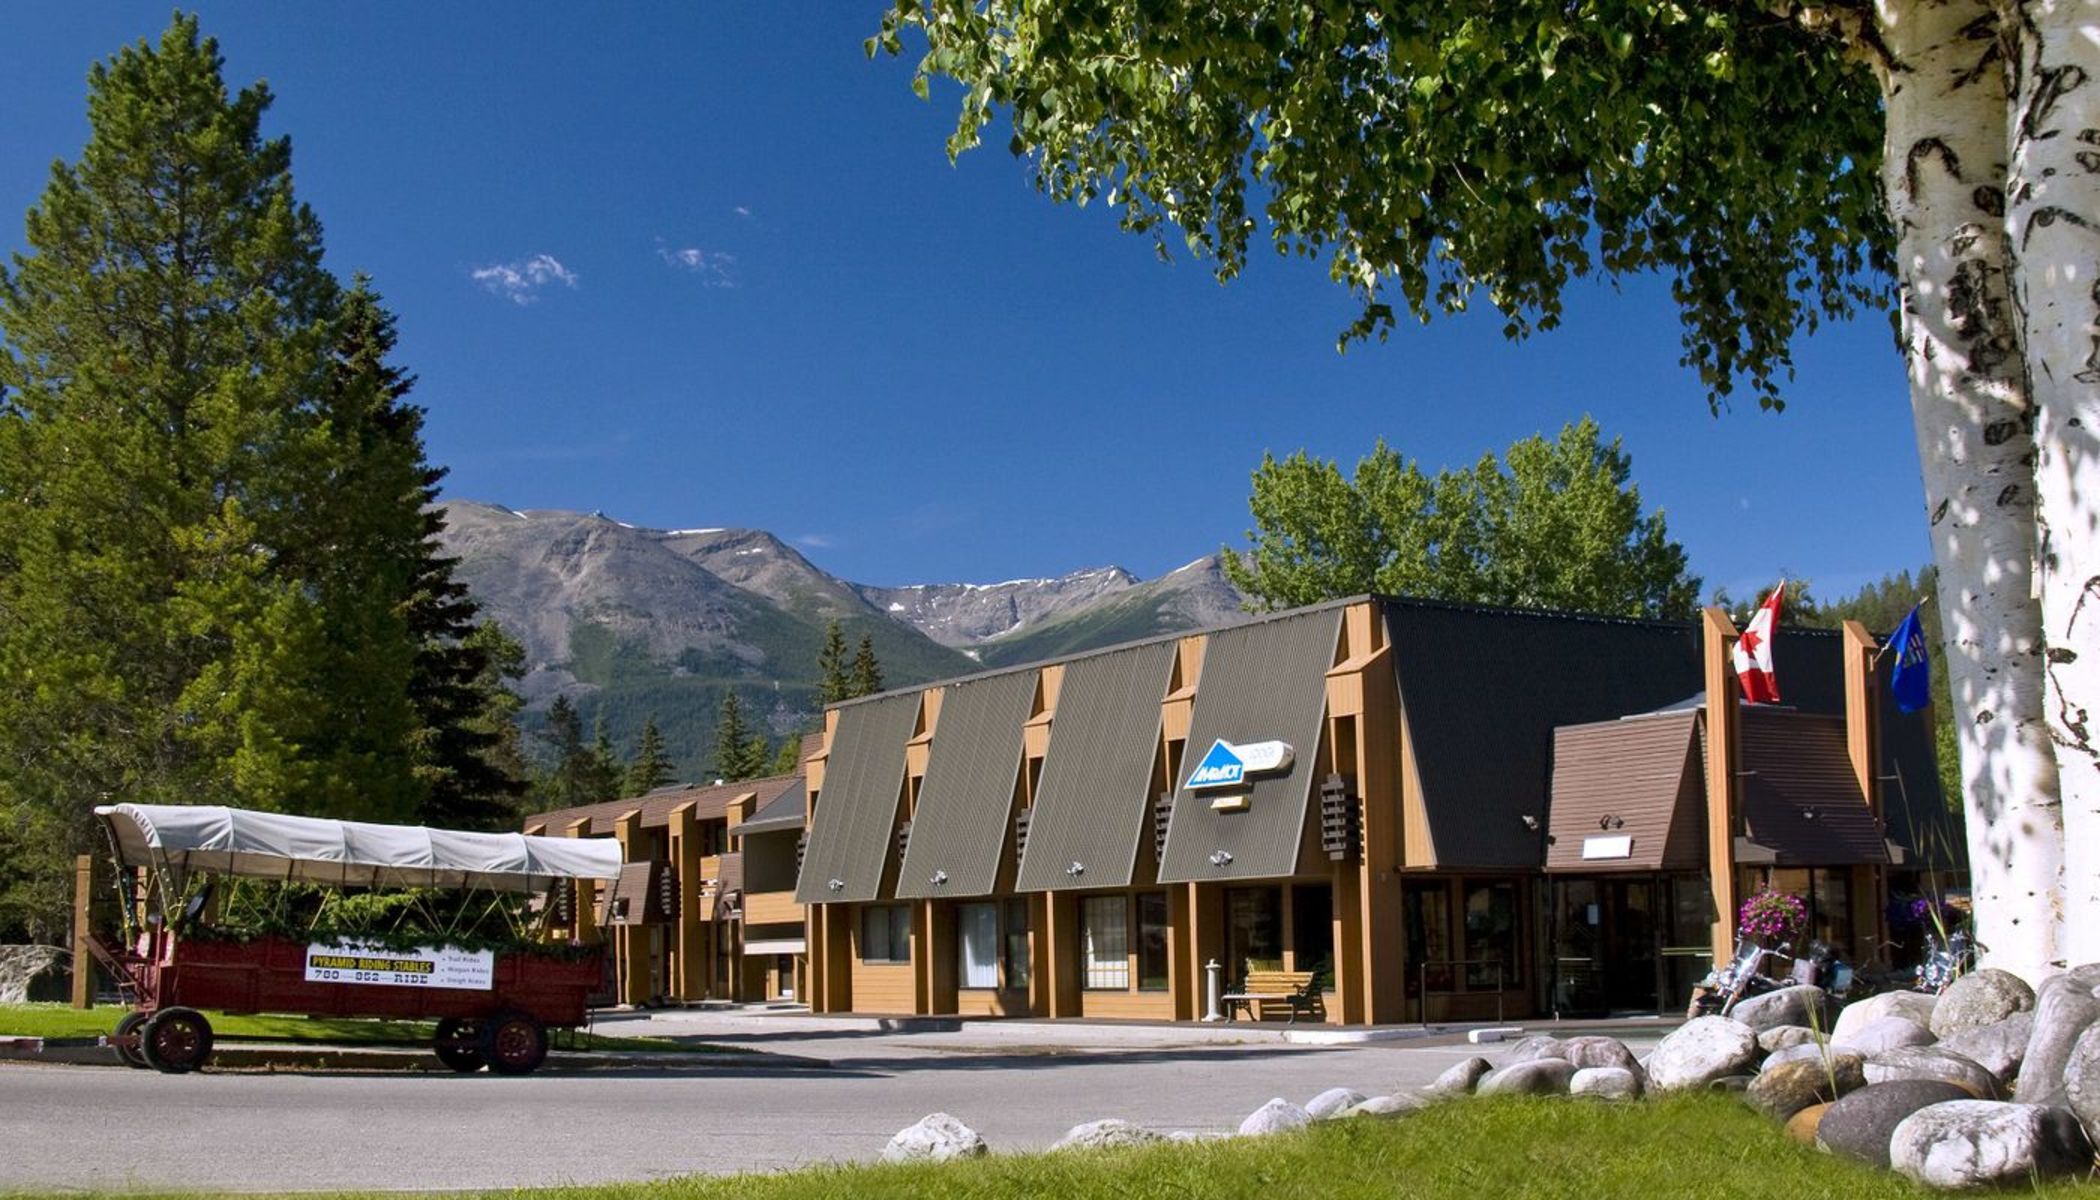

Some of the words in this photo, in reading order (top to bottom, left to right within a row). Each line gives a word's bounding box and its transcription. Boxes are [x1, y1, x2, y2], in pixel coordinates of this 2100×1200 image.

[312, 956, 357, 969] PYRAMID
[358, 958, 391, 971] RIDING
[393, 960, 431, 973] STABLES
